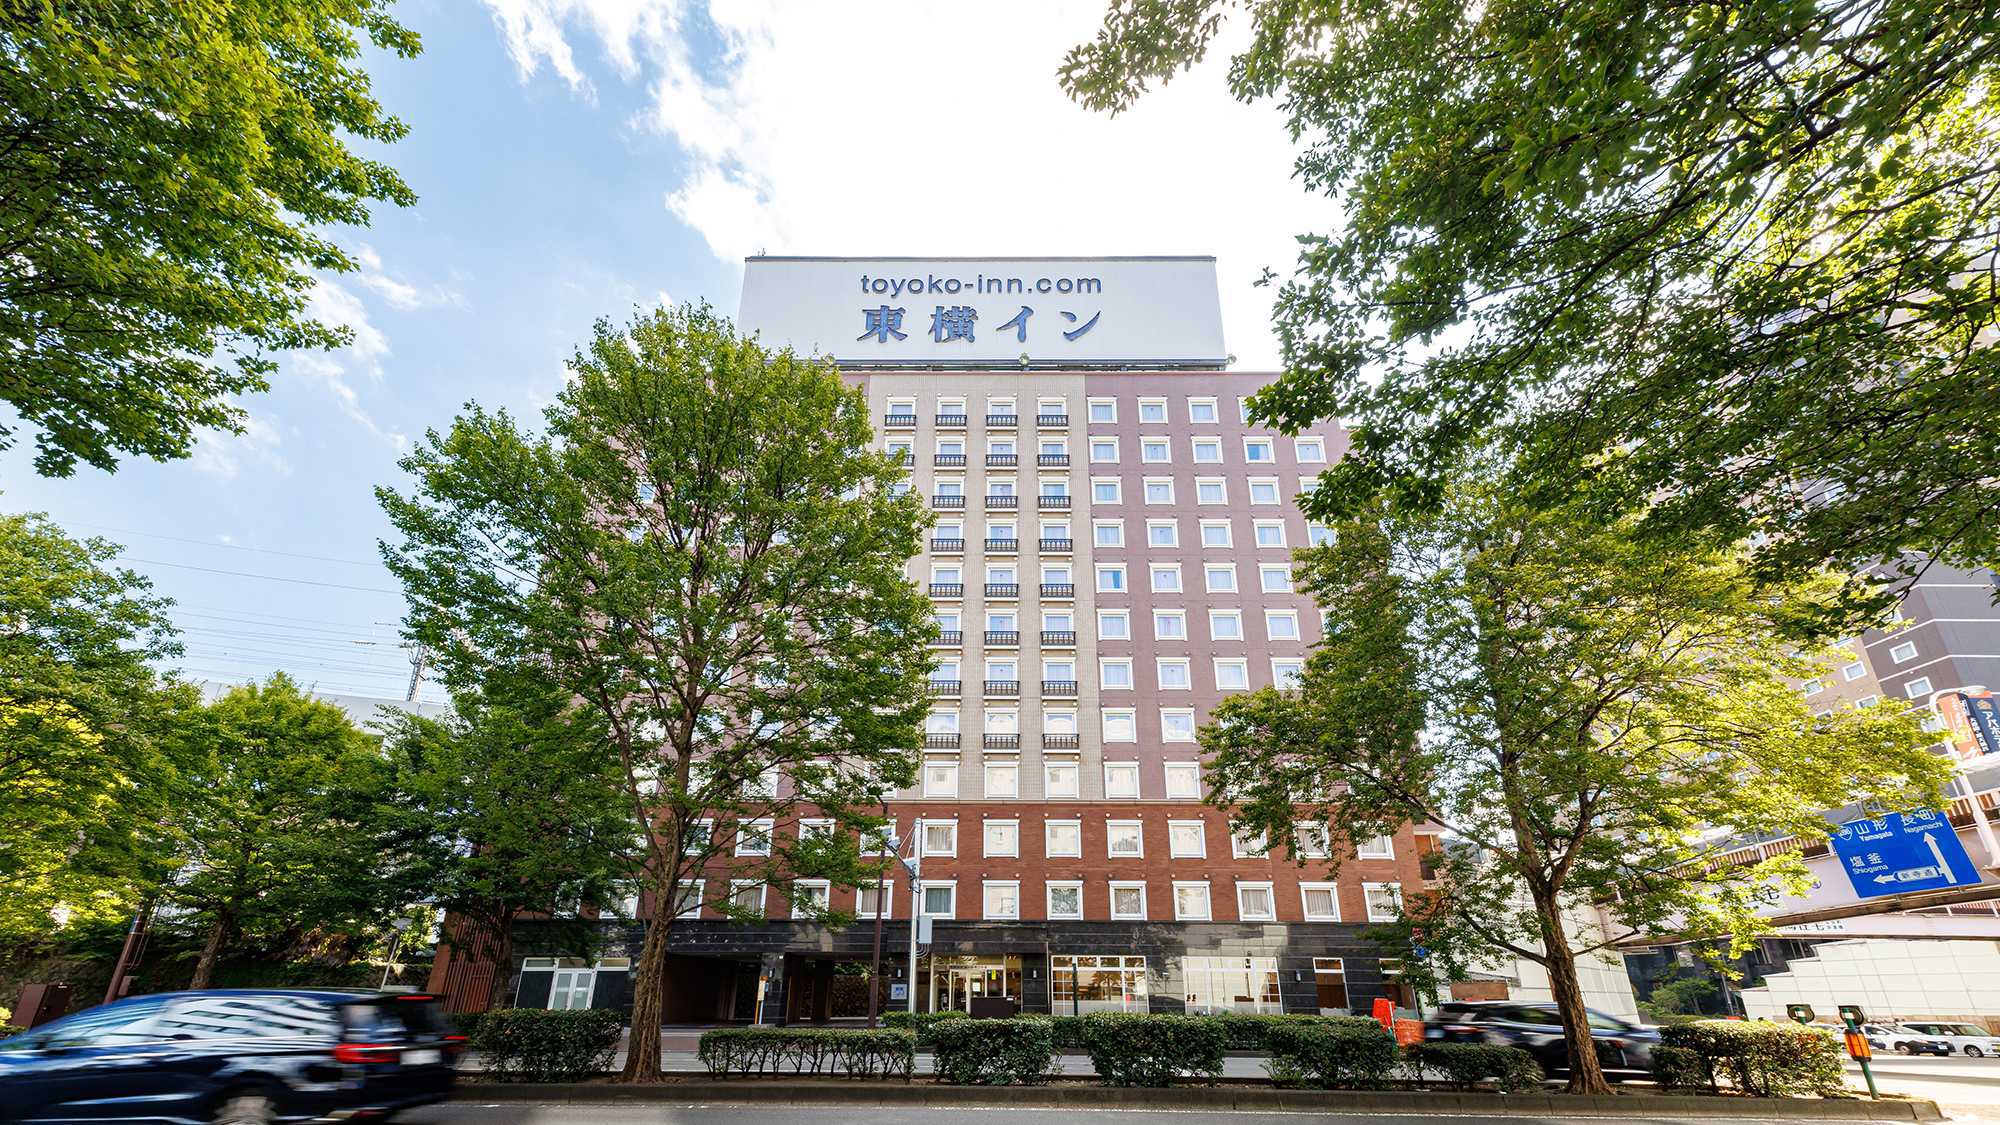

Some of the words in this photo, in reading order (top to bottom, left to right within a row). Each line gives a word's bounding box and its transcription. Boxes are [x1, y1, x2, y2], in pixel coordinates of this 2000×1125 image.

[861, 275, 1101, 298] toyoko-inn.com
[857, 304, 1101, 344] 東横イン
[1855, 818, 1887, 834] 山形
[1904, 822, 1943, 833] Nagamachi
[1860, 831, 1893, 841] Yamagata
